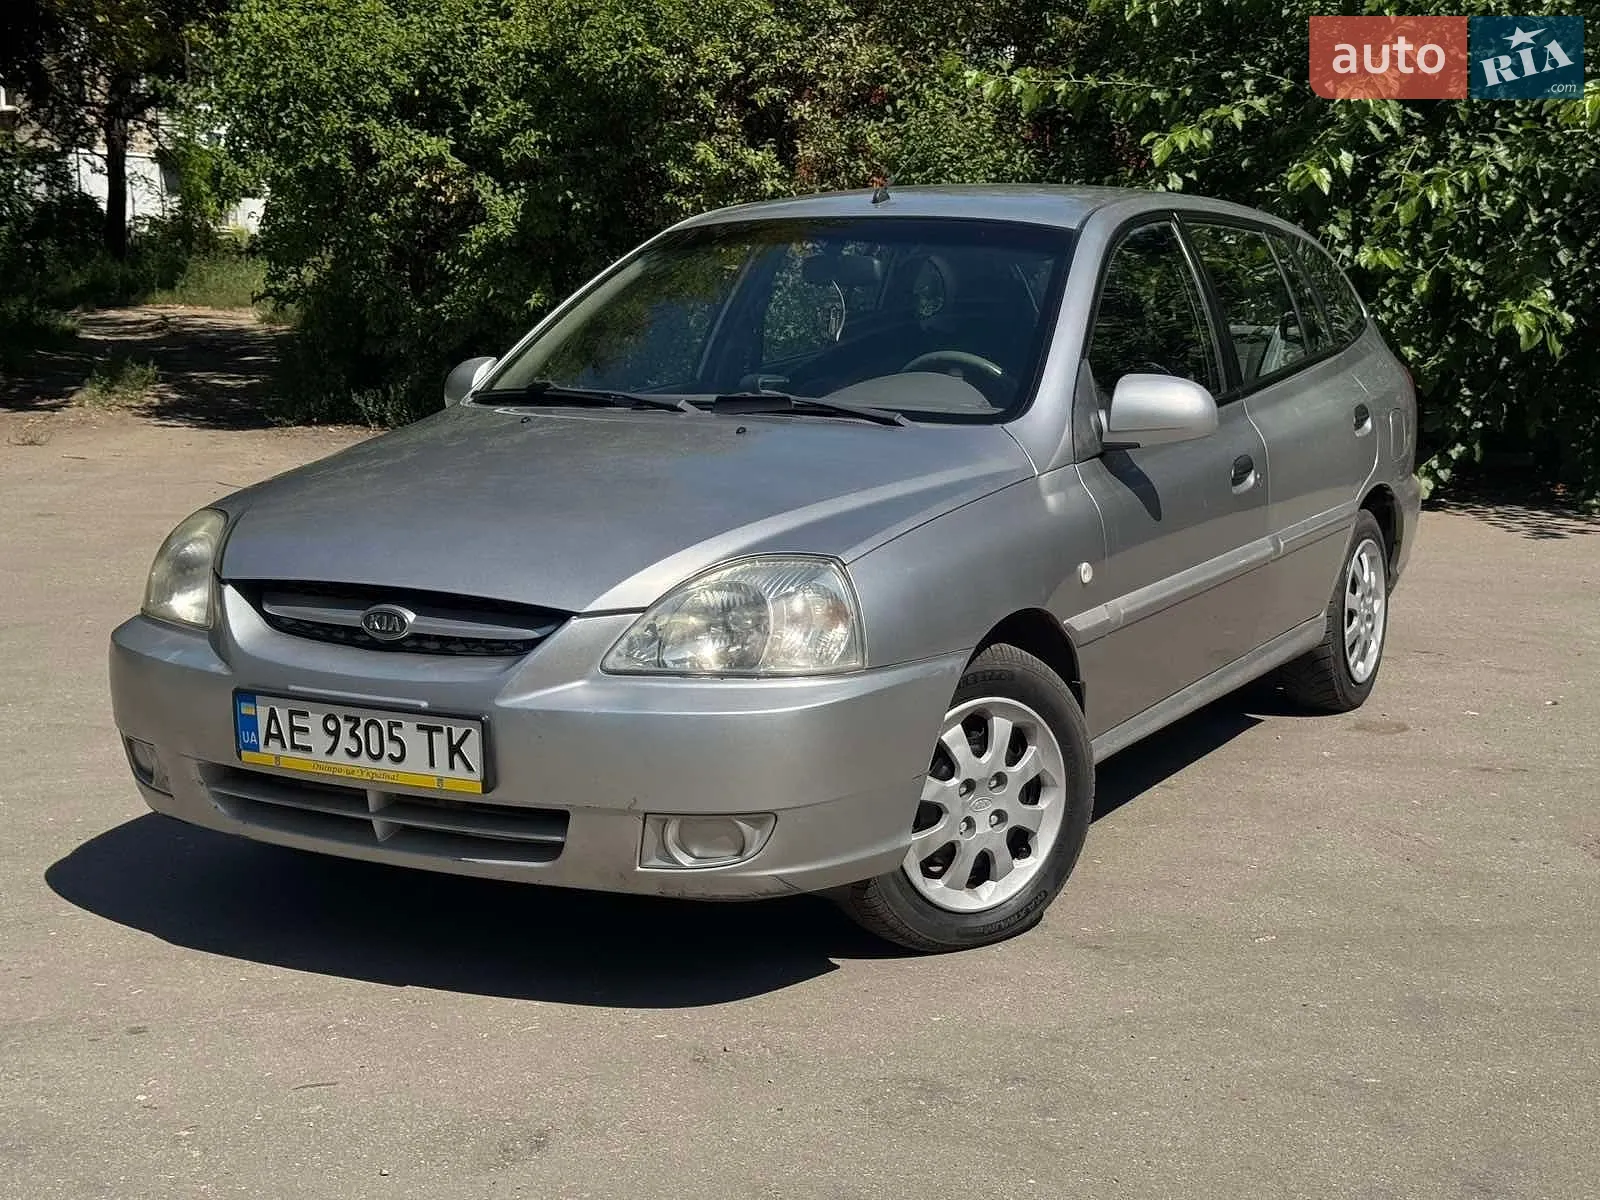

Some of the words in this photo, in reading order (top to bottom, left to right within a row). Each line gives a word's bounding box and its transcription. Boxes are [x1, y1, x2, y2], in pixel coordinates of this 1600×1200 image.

[369, 614, 401, 632] KIA
[242, 731, 258, 745] UA
[263, 706, 313, 753] AE
[322, 713, 407, 764] 9305
[415, 723, 476, 773] TK
